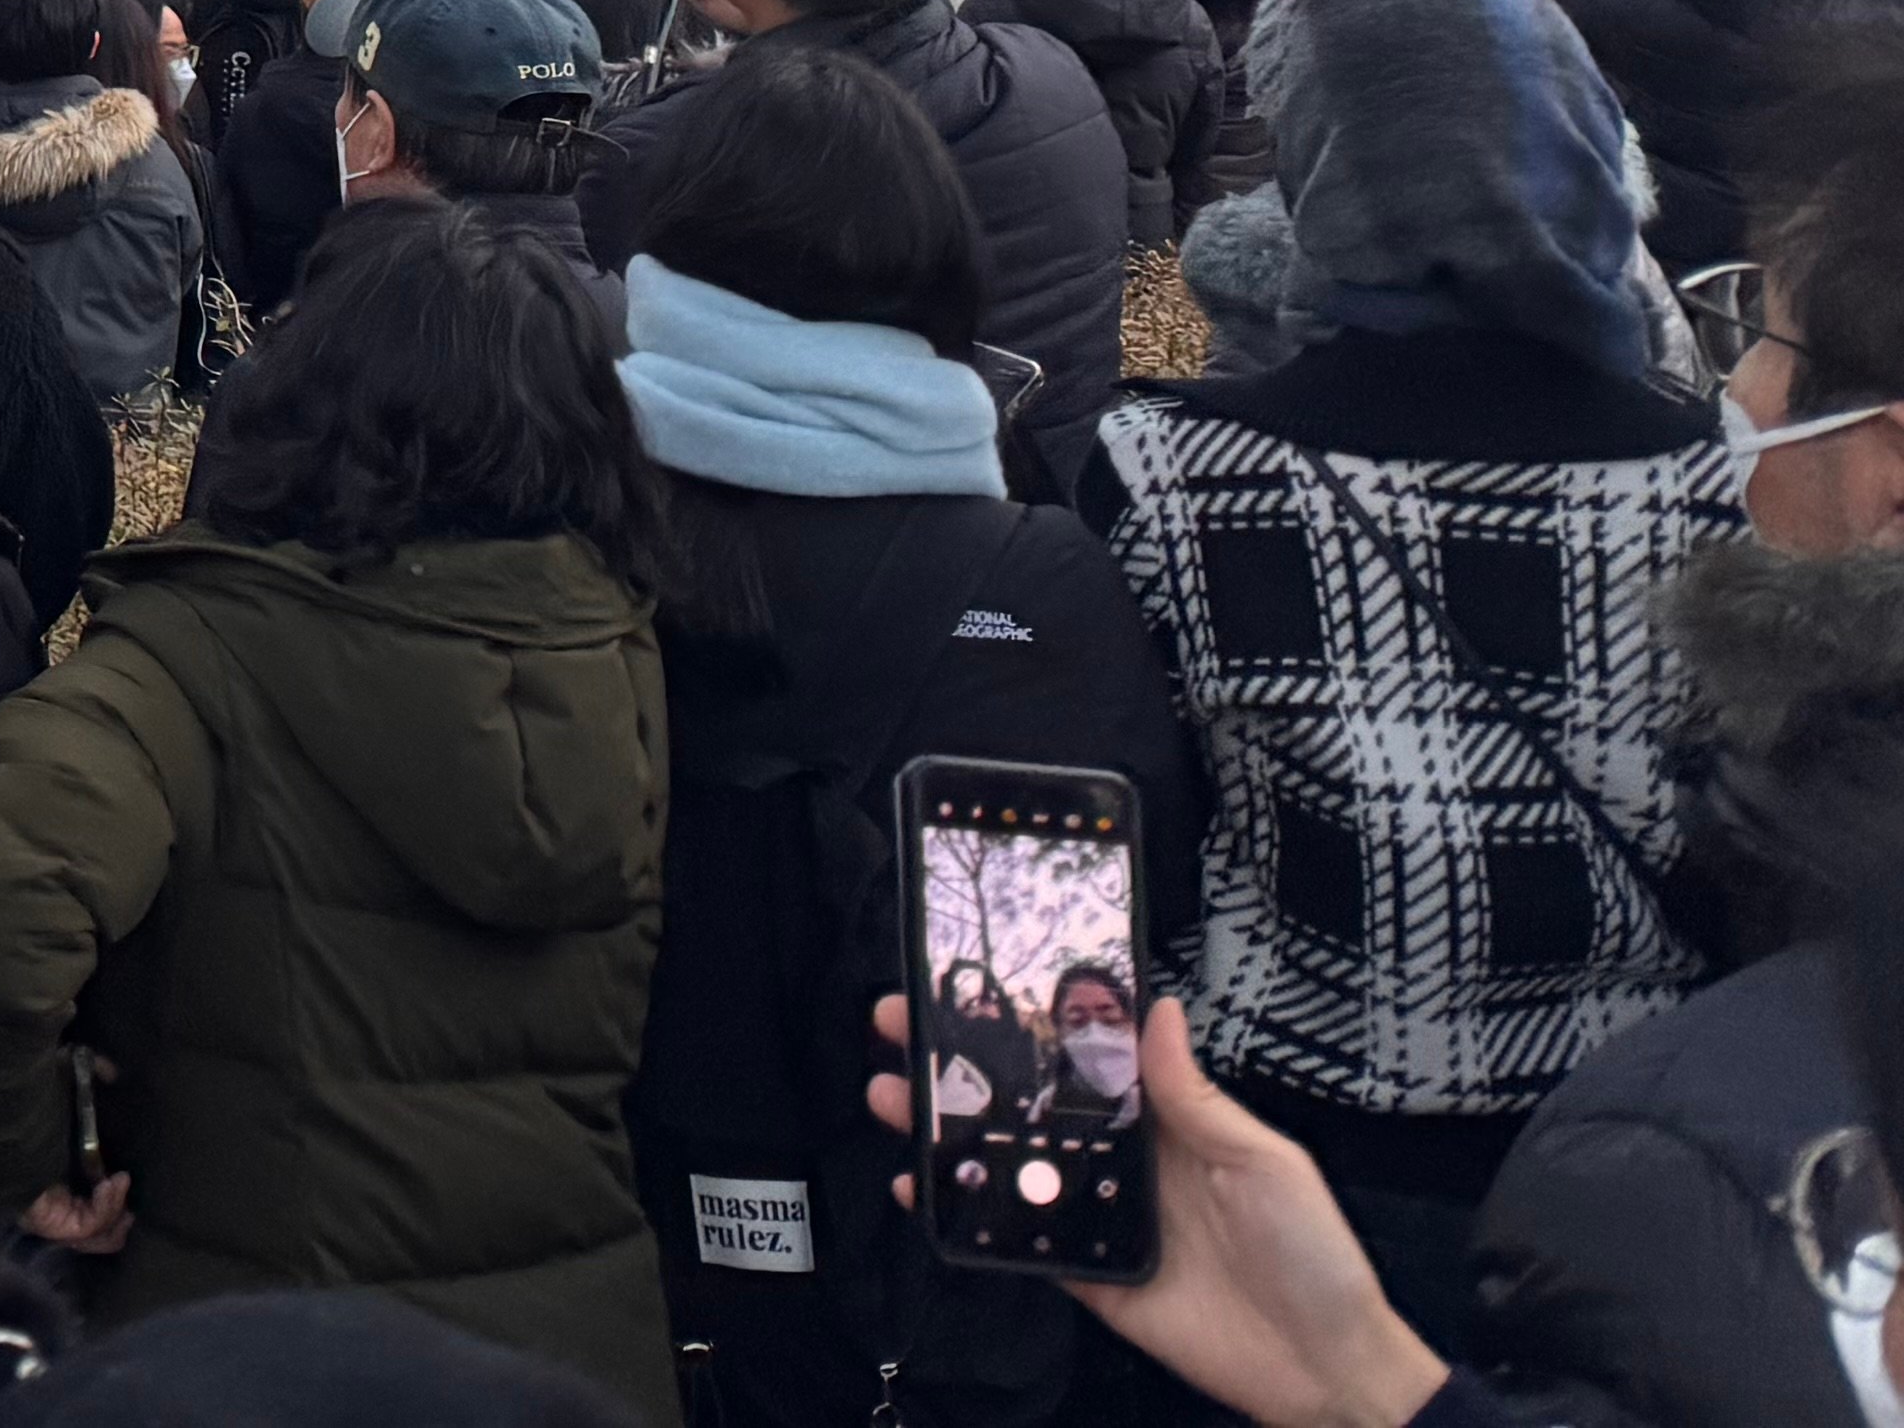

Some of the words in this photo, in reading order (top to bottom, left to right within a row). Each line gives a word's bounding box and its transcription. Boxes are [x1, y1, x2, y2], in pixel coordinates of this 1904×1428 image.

[357, 21, 382, 71] 3
[517, 62, 576, 80] POLO
[959, 610, 1017, 627] ATIONAL
[952, 624, 1034, 642] EOGRAPHIC
[698, 1194, 806, 1223] masma
[703, 1223, 793, 1254] rulez.
